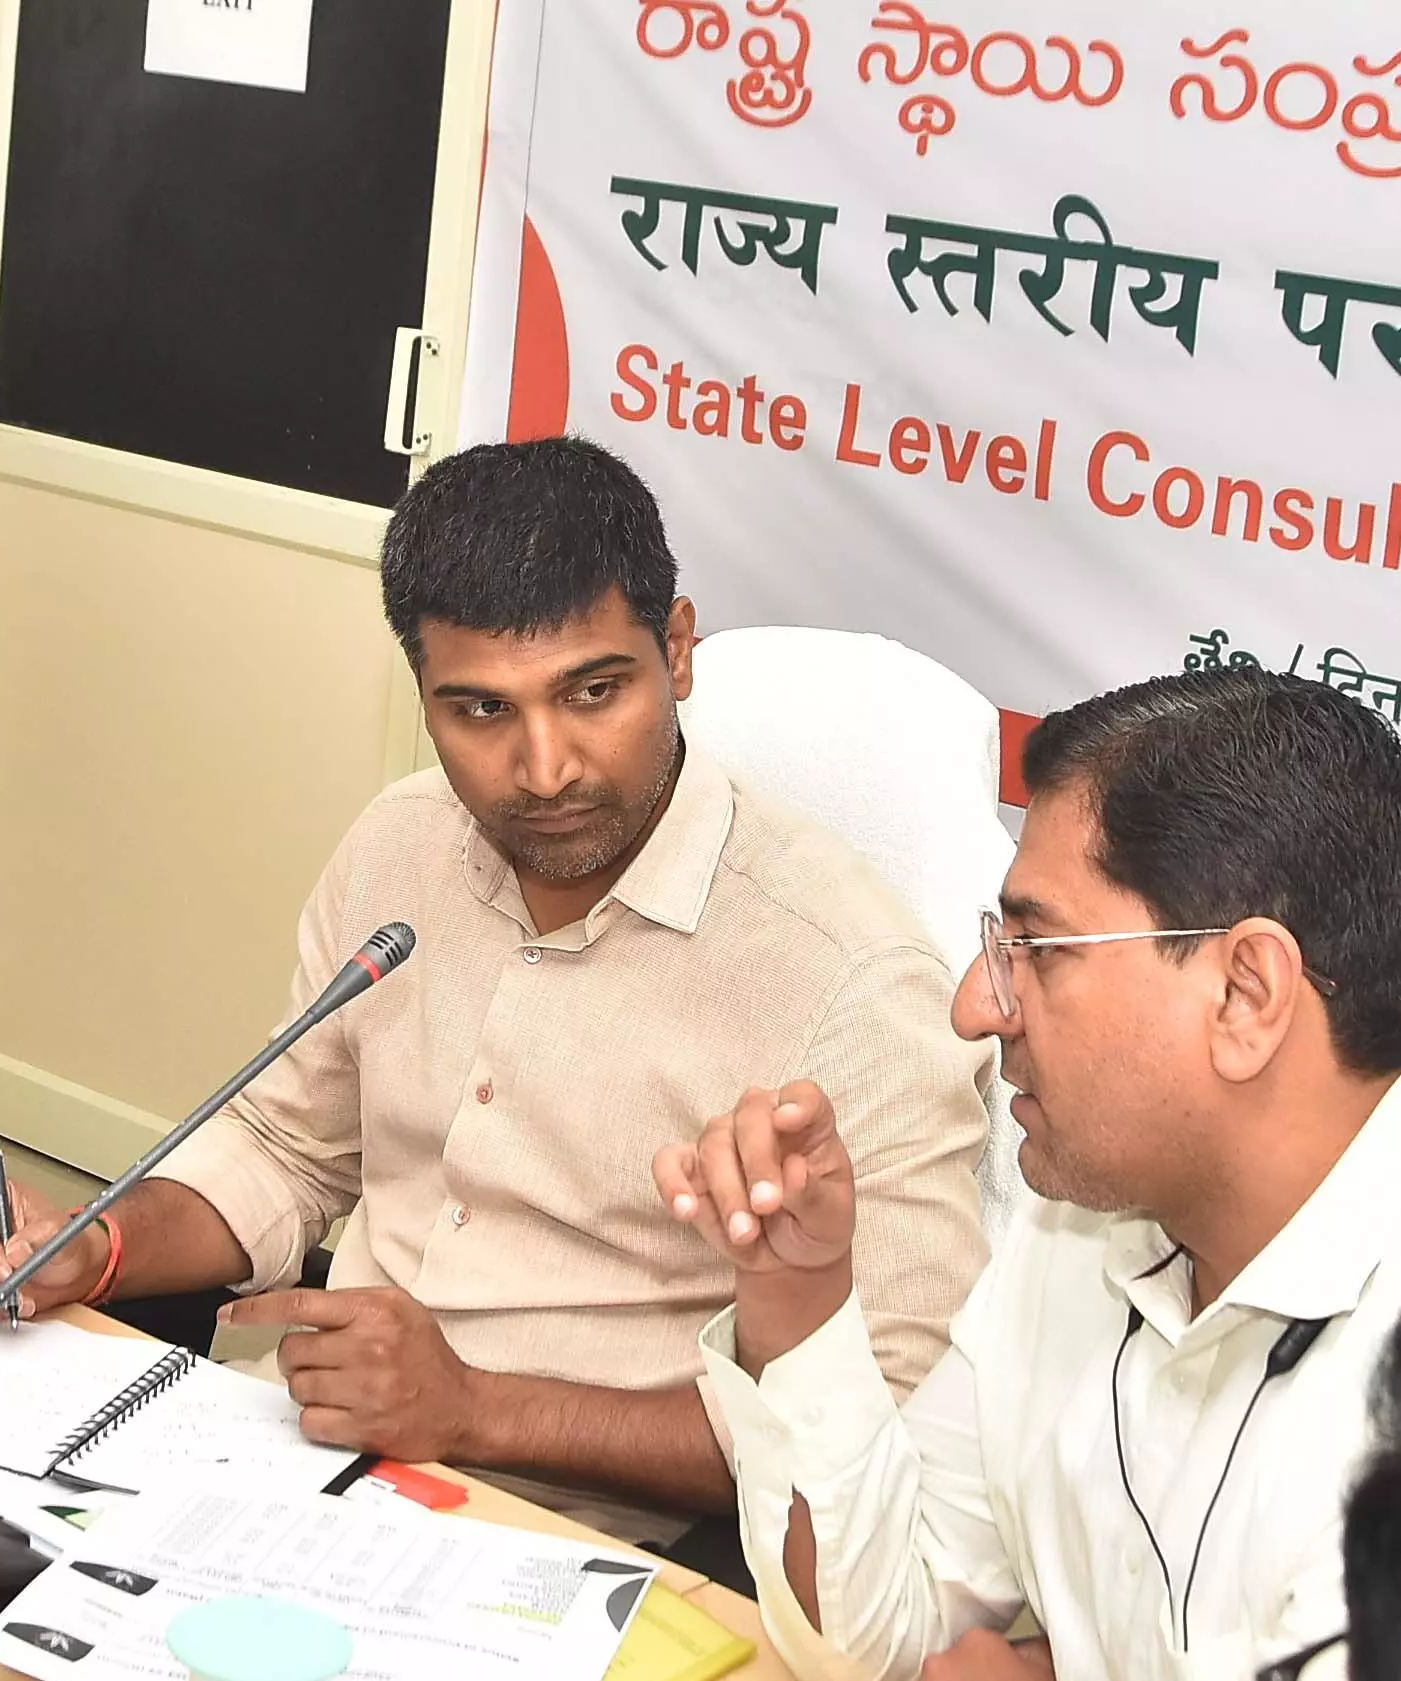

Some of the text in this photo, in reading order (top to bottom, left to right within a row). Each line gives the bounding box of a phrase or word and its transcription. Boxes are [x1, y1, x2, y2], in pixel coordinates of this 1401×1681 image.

[857, 0, 1125, 157] స్థాయి
[612, 177, 839, 295] राज्य
[885, 194, 1220, 356] स्तरीय
[610, 344, 1401, 569] State Level Consul
